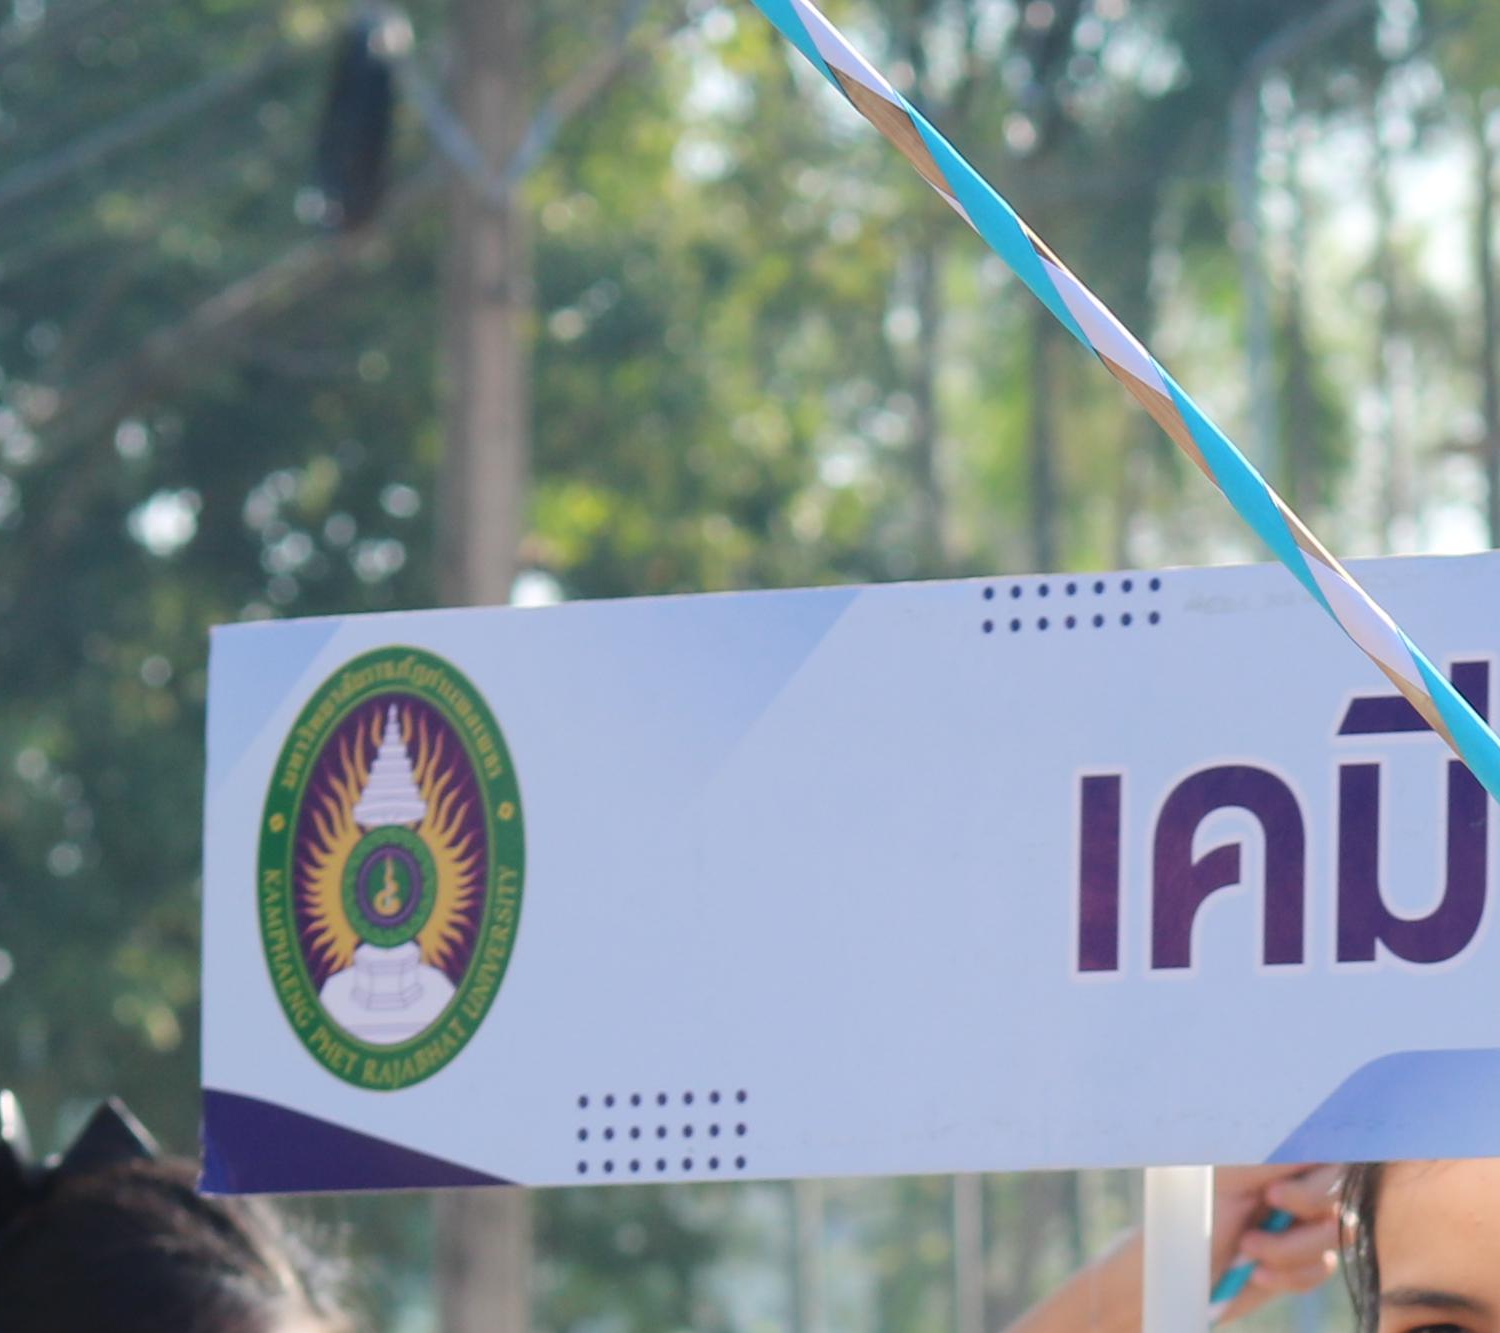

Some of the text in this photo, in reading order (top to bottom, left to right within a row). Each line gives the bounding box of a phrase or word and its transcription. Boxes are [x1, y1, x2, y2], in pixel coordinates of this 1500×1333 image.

[1078, 660, 1489, 972] เคมี
[264, 866, 518, 1087] KAMPHAENG PHET RAJABHAT UNIVERSITY
